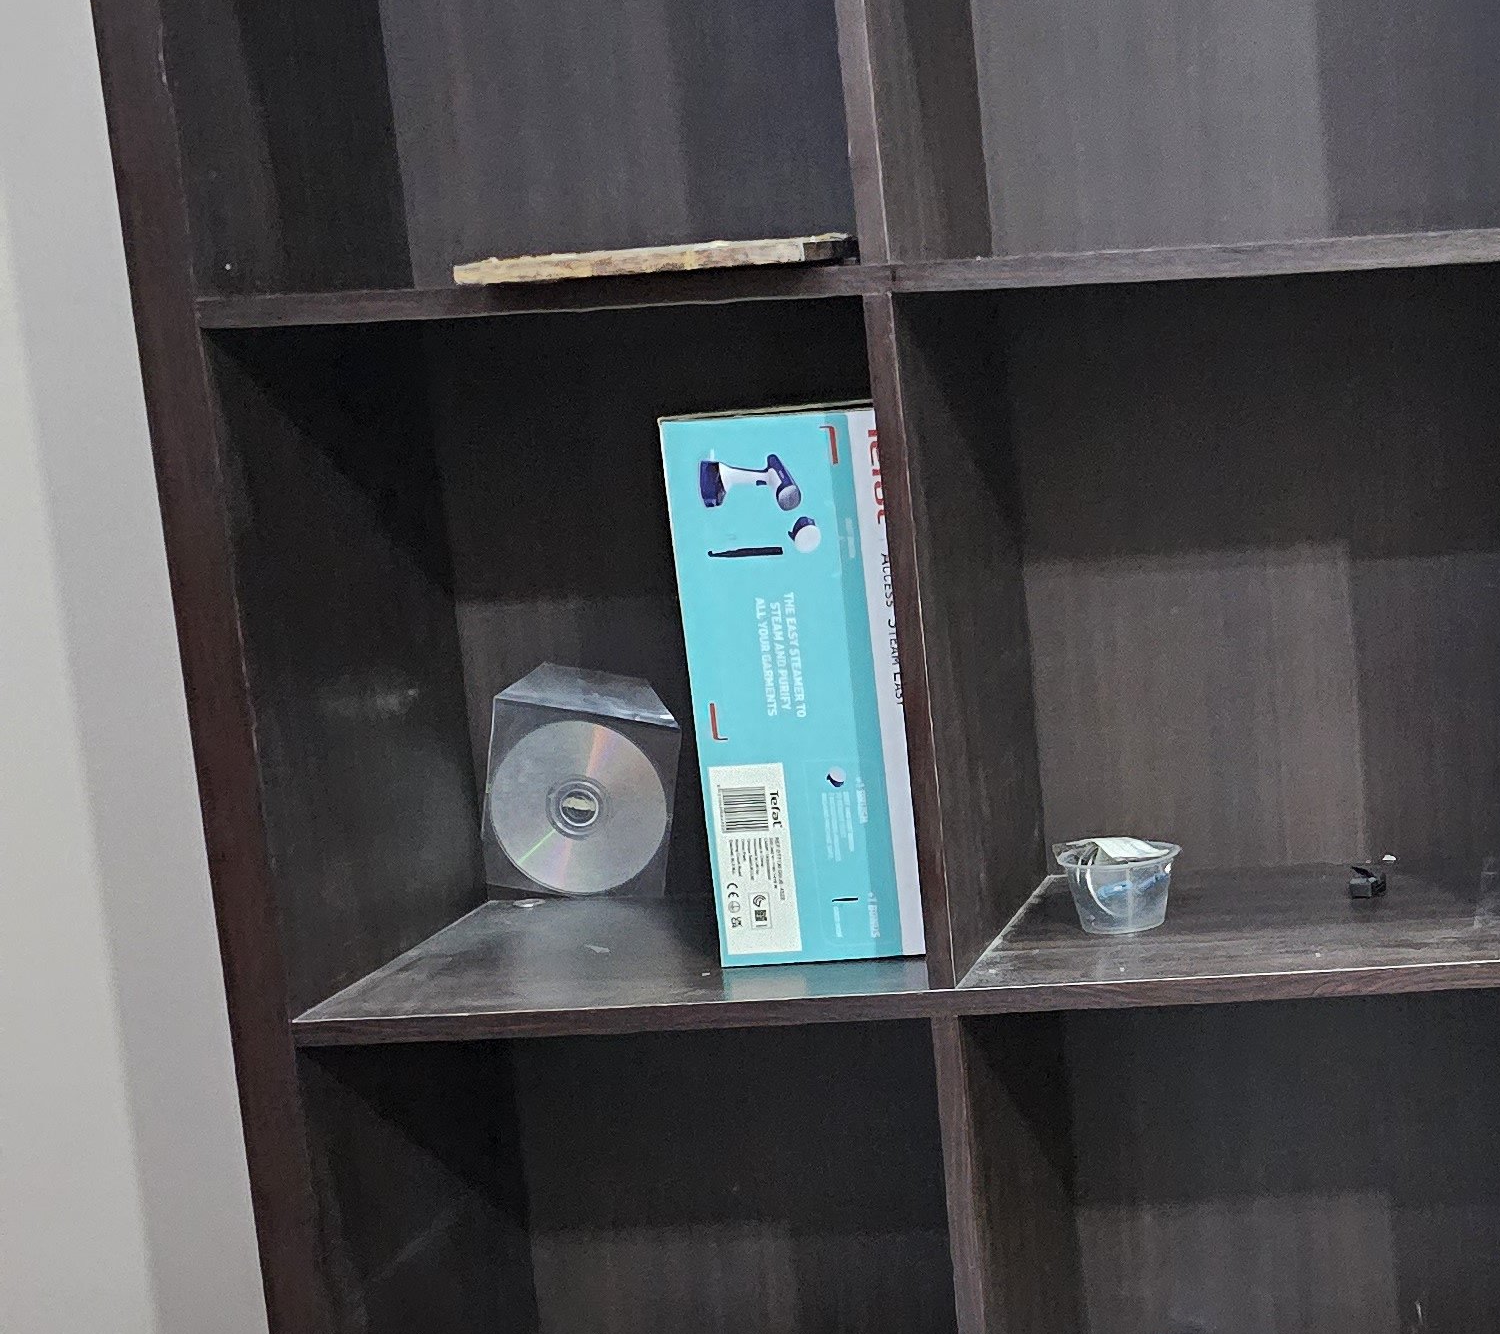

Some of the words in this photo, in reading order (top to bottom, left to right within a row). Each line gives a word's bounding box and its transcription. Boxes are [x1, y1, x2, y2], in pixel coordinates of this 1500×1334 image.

[755, 597, 767, 620] ALL
[784, 592, 796, 616] THE
[758, 621, 771, 653] YOUR
[770, 602, 785, 641] STEAM
[786, 618, 800, 647] EASY
[774, 642, 787, 668] AND
[762, 654, 778, 717] GARMENTS
[778, 669, 792, 710] PURIFY
[789, 649, 805, 702] STEAMER
[796, 703, 807, 718] TO
[769, 790, 782, 828] Tefal
